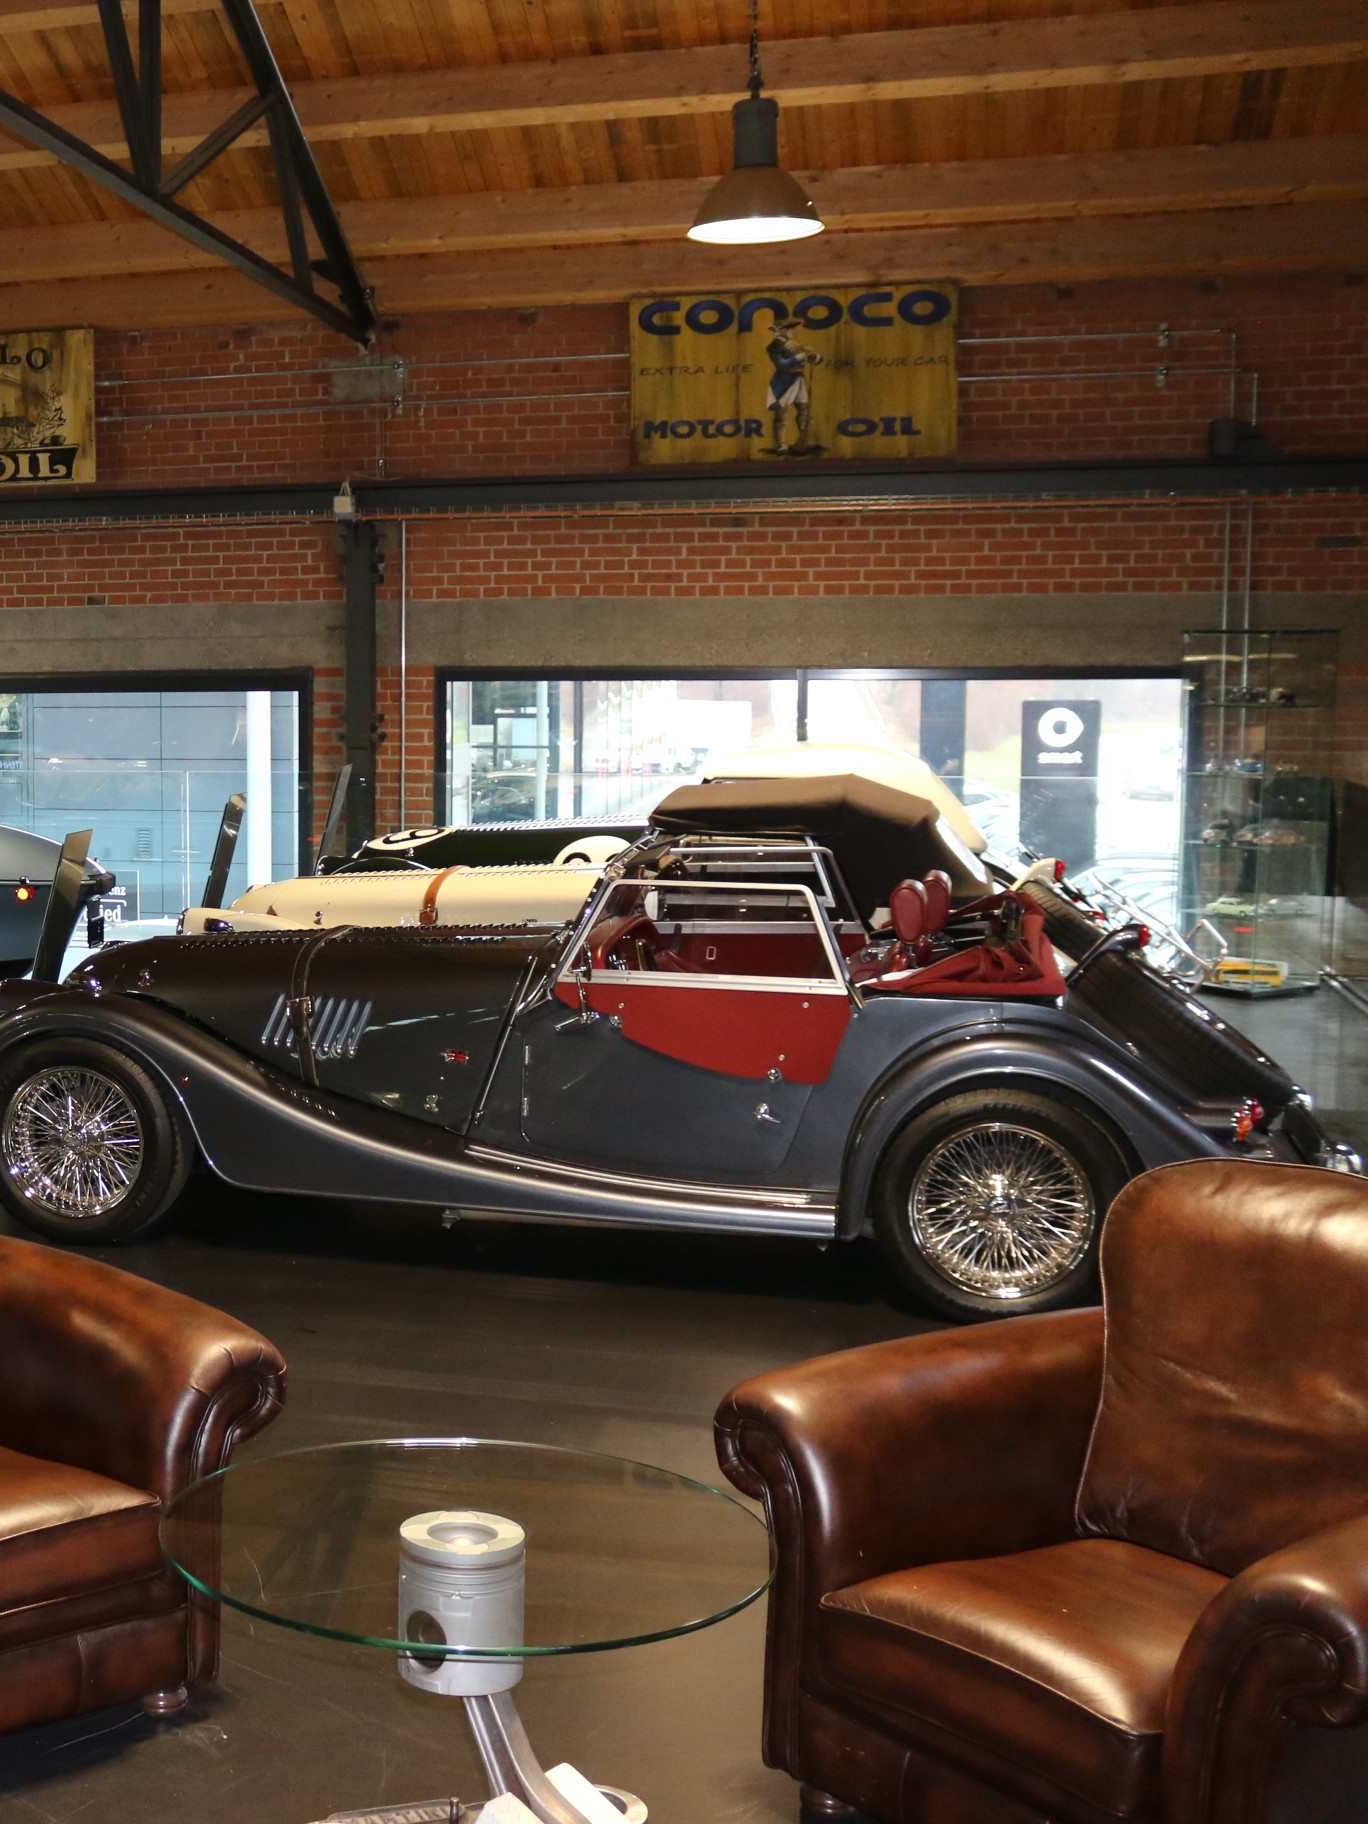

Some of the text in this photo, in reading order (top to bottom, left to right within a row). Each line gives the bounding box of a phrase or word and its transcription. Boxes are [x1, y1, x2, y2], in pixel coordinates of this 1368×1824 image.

[638, 290, 952, 336] CONOCO
[639, 365, 705, 377] EXTRA
[715, 363, 755, 376] LIFE
[864, 355, 908, 368] YOUR
[913, 354, 950, 367] CAR
[643, 416, 922, 440] MOTOR OIL
